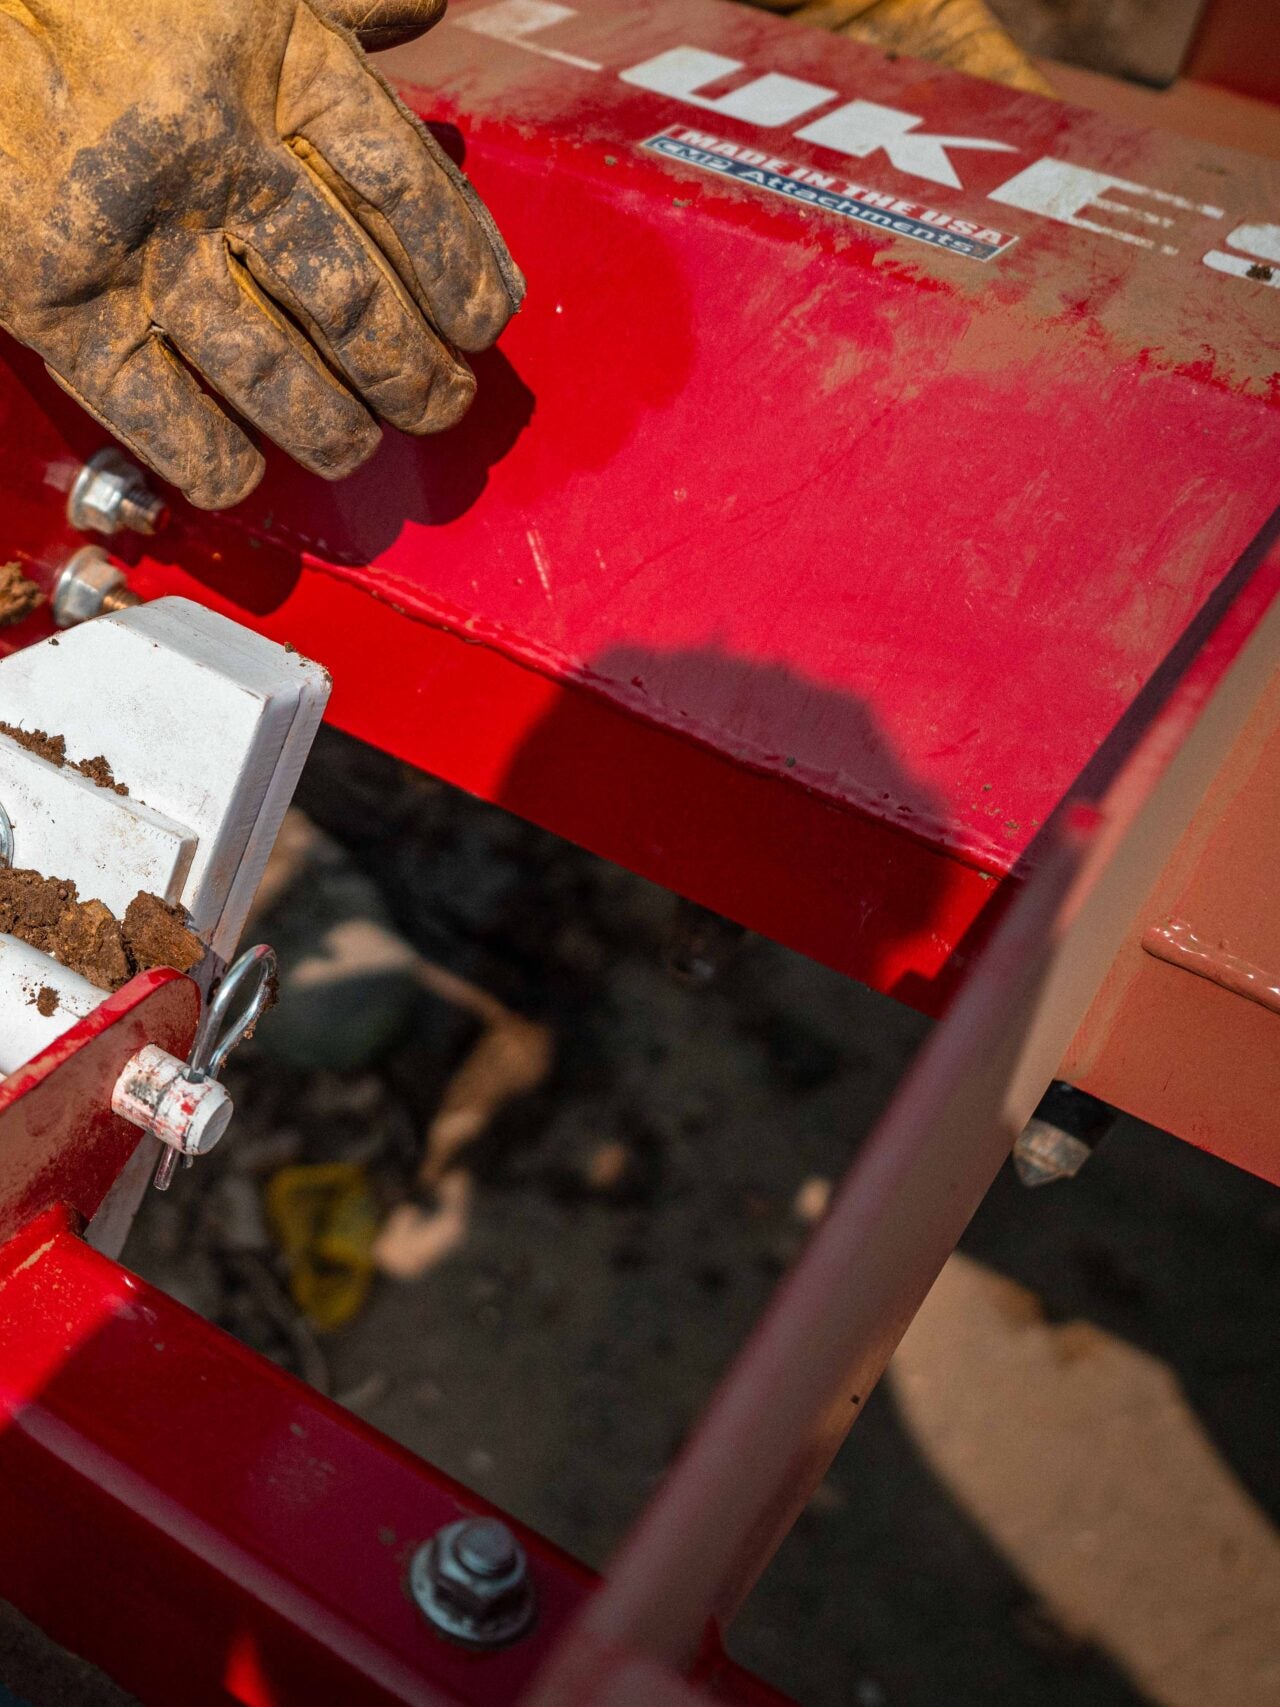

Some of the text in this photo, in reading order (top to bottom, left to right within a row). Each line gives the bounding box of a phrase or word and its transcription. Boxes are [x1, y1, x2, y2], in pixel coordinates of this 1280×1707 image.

[677, 130, 1002, 245] MADE IN THE USA
[737, 170, 975, 252] Attachments
